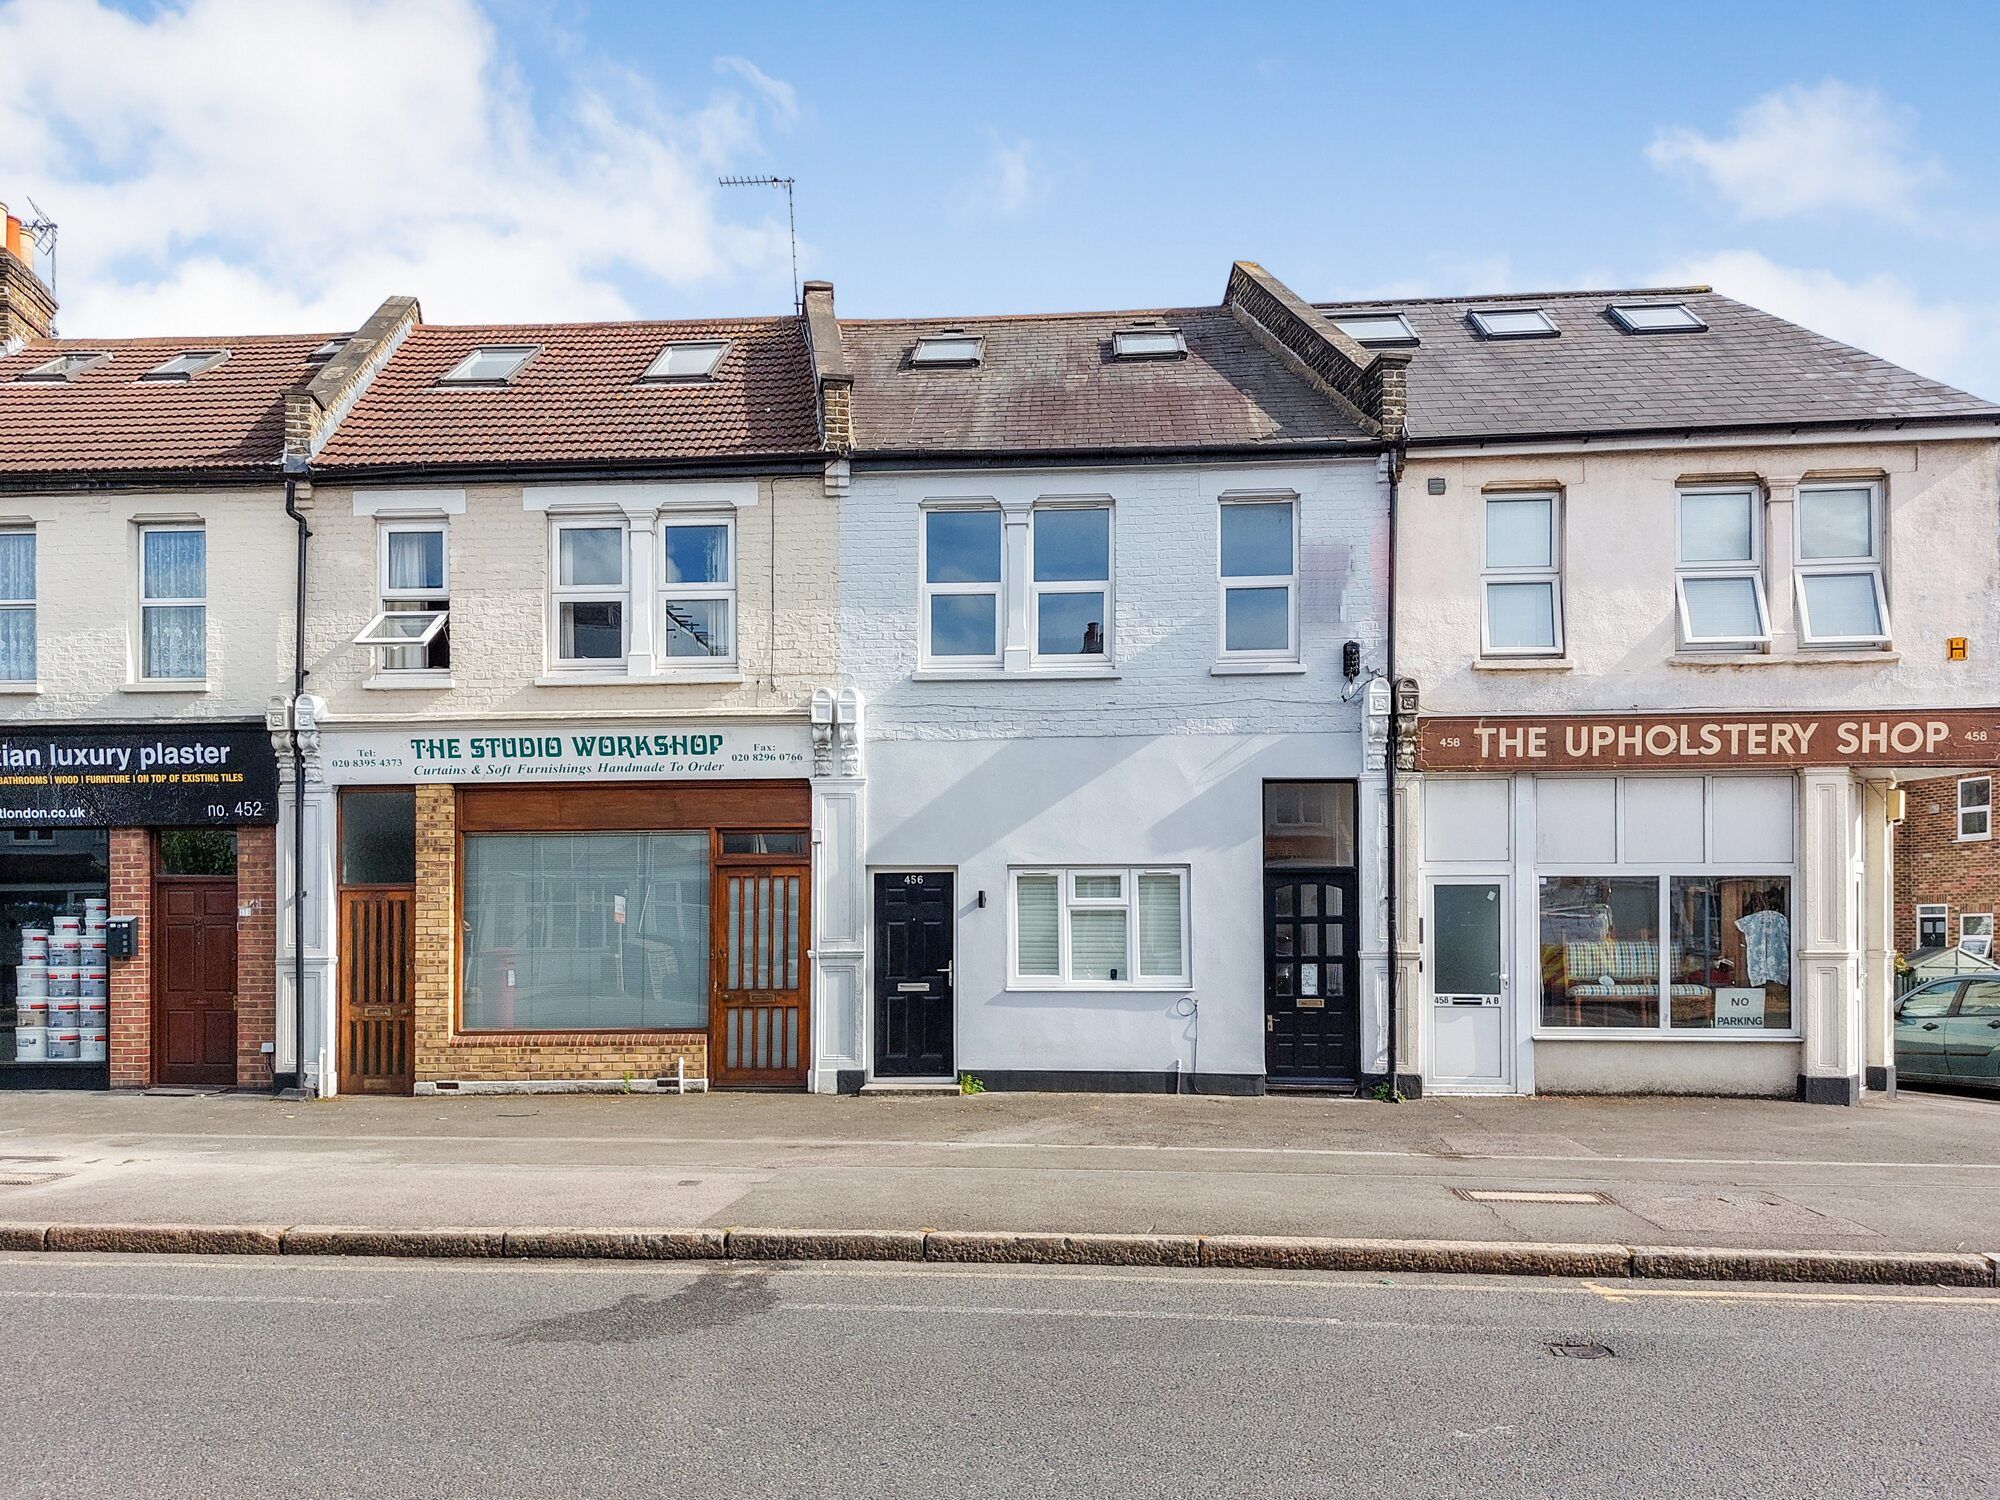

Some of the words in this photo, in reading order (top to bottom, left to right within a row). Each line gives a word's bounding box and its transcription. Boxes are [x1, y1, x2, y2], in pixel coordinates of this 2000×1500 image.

[1473, 727, 1547, 758] THE
[1565, 722, 1819, 758] UPHOLSTERY
[1836, 721, 1950, 755] SHOP
[1964, 730, 1988, 742] 458
[410, 738, 462, 760] THE
[470, 736, 563, 759] STUDIO
[572, 734, 724, 759] WORKSHOP
[753, 743, 776, 752] Fax:
[1439, 737, 1461, 748] 458
[0, 744, 41, 767] ian
[49, 743, 132, 771] luxury
[140, 742, 230, 770] plaster
[356, 749, 377, 758] Tel:
[731, 753, 750, 762] 020
[752, 753, 776, 762] 8296
[779, 752, 803, 762] 0766
[331, 759, 350, 768] 020
[352, 759, 376, 768] 8395
[379, 758, 403, 767] 4373
[413, 764, 467, 776] Curtains
[471, 764, 481, 775] &
[485, 763, 512, 777] Soft
[517, 762, 593, 776] Furnishings
[597, 761, 665, 773] Handmade
[670, 761, 684, 772] To
[688, 761, 725, 772] Order
[0, 775, 48, 785] BATHROOMS
[54, 775, 79, 785] WOOD
[85, 774, 131, 784] FURNITURE
[137, 774, 149, 783] ON
[151, 774, 167, 783] TOP
[169, 774, 180, 783] OF
[181, 773, 219, 783] EXISTING
[221, 773, 244, 782] TILES
[207, 804, 229, 817] no.
[234, 801, 262, 817] 452
[903, 875, 924, 885] 456
[1731, 997, 1750, 1007] NO
[1717, 1016, 1763, 1026] PARKING
